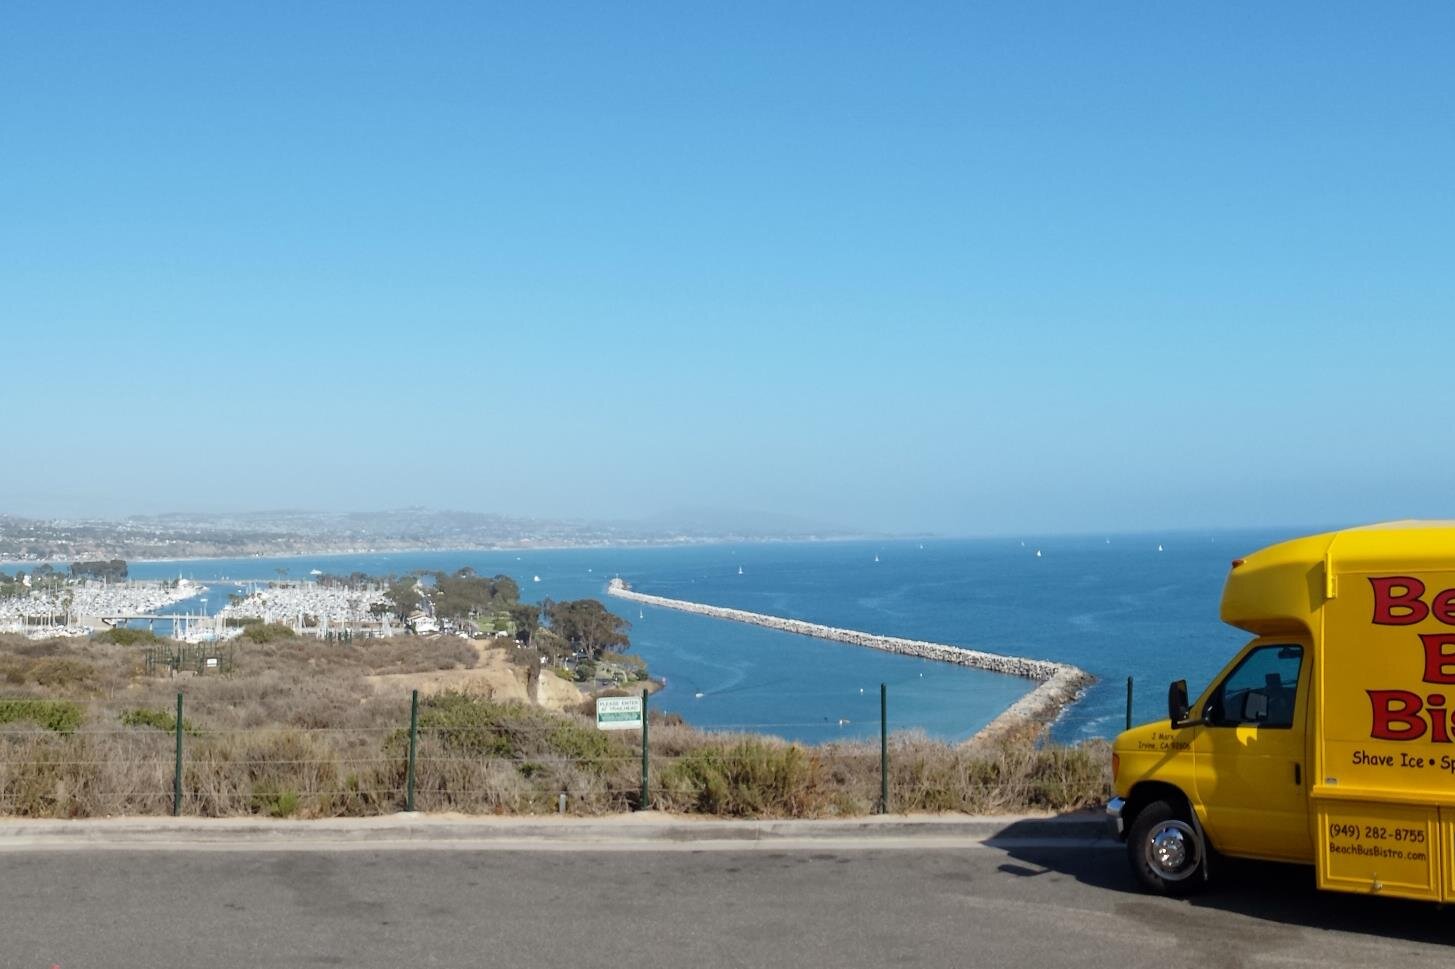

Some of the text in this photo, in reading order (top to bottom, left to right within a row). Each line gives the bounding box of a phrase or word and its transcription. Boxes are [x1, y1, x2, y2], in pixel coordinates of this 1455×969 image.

[1352, 750, 1394, 767] Shave
[1400, 753, 1424, 768] Ice
[1329, 823, 1425, 843] (949) 282-8755
[1329, 842, 1426, 860] BeachBusBistro.com
